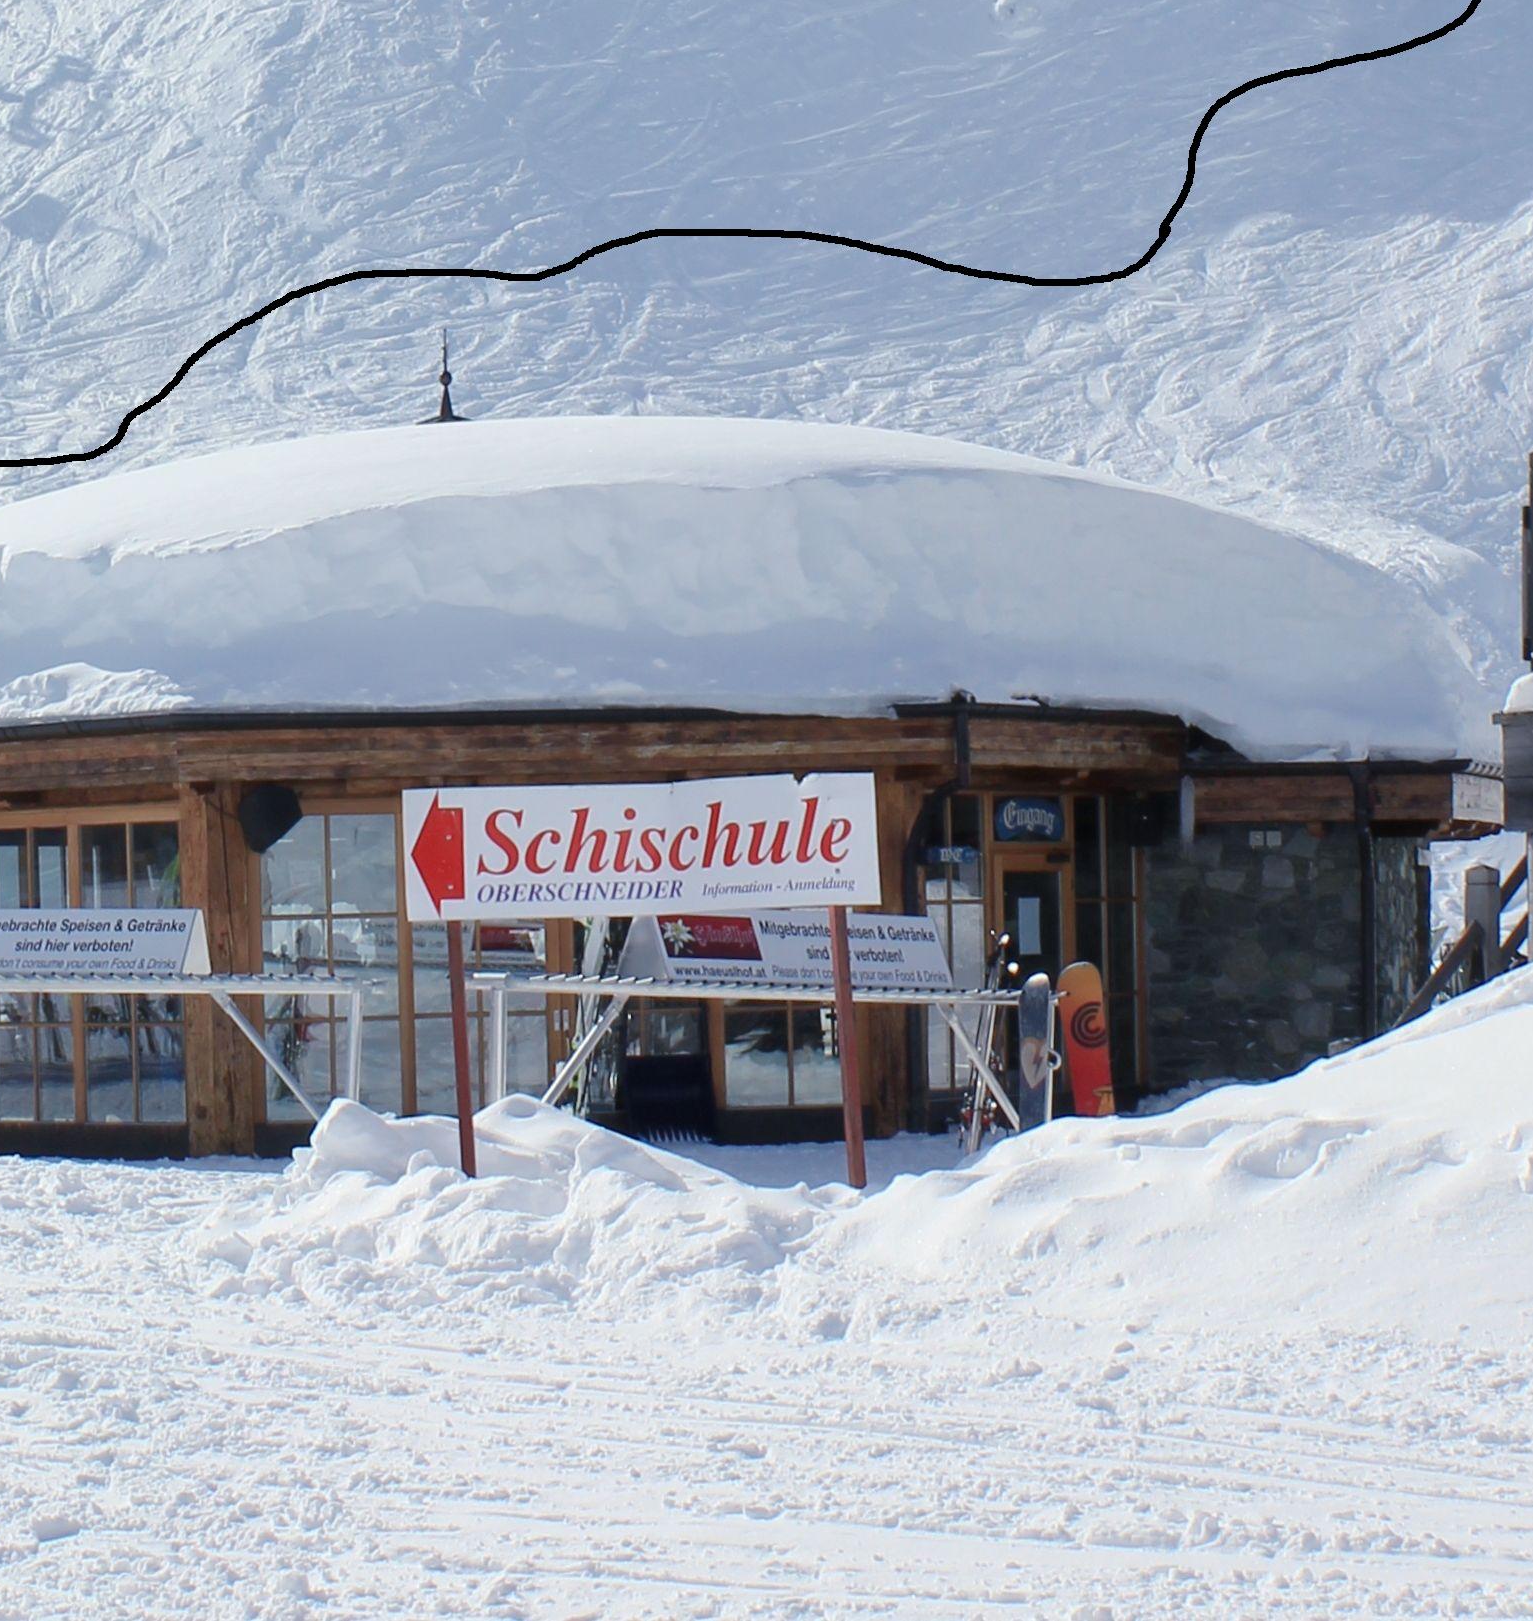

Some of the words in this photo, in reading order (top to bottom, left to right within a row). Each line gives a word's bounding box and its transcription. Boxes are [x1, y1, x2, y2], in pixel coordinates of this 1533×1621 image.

[1003, 800, 1055, 835] Eingang
[477, 796, 852, 875] Schischule
[477, 880, 683, 904] OBERSCHNEIDER
[702, 881, 773, 898] Information
[783, 877, 856, 894] Anmeldung
[60, 918, 111, 933] Speisen
[114, 918, 123, 931] &
[127, 918, 186, 932] Getränke
[758, 920, 831, 939] Mitgebrachte
[877, 925, 886, 940] &
[887, 926, 936, 942] Getränke
[15, 940, 42, 952] sind
[45, 940, 70, 952] hier
[73, 940, 134, 952] verboten!
[806, 945, 830, 960] sind
[854, 949, 905, 963] verboten!
[23, 959, 64, 969] consume
[65, 959, 87, 972] your
[88, 960, 110, 969] own
[111, 957, 137, 969] Food
[138, 957, 145, 969] &
[147, 957, 177, 969] Drinks
[674, 965, 766, 978] www.haeuslhof.at
[772, 964, 798, 979] Please
[859, 970, 876, 983] your
[877, 971, 893, 981] own
[894, 968, 915, 982] Food
[924, 970, 948, 984] Drinks
